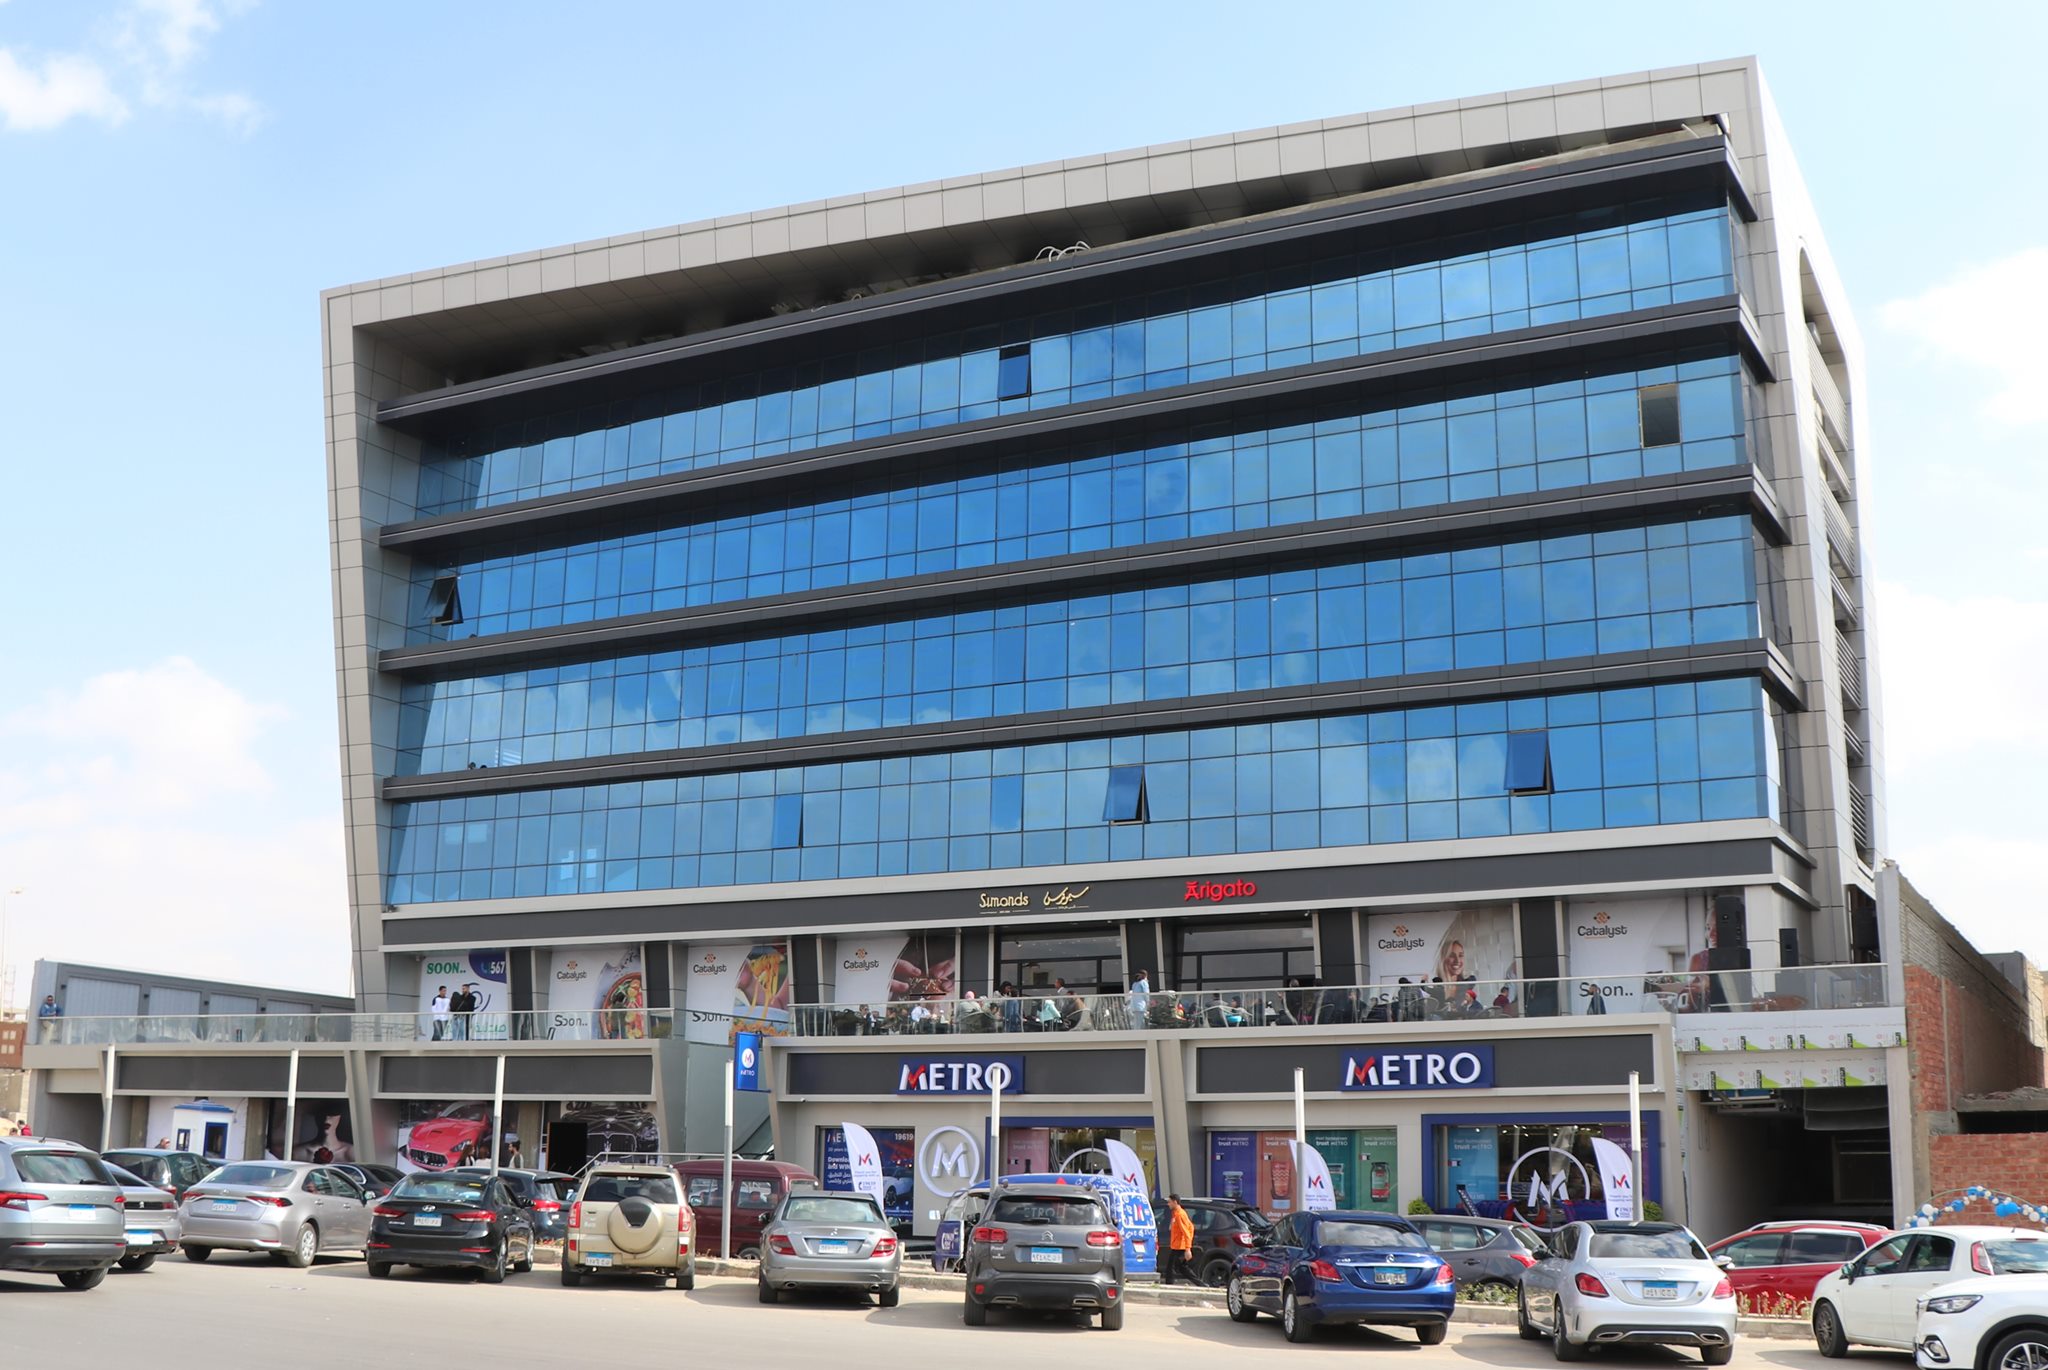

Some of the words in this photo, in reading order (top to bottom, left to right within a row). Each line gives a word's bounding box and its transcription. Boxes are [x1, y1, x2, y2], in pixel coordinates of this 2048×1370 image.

[1184, 879, 1257, 902] Arigato
[979, 891, 1028, 908] Simonds
[1577, 925, 1628, 938] Catalyst
[1378, 938, 1425, 951] Catalyst
[693, 964, 727, 975] Catalyst
[843, 960, 879, 971] Catalyst
[557, 971, 587, 981] Catalyst
[899, 1061, 1012, 1091] METRO
[1345, 1052, 1482, 1087] METRO
